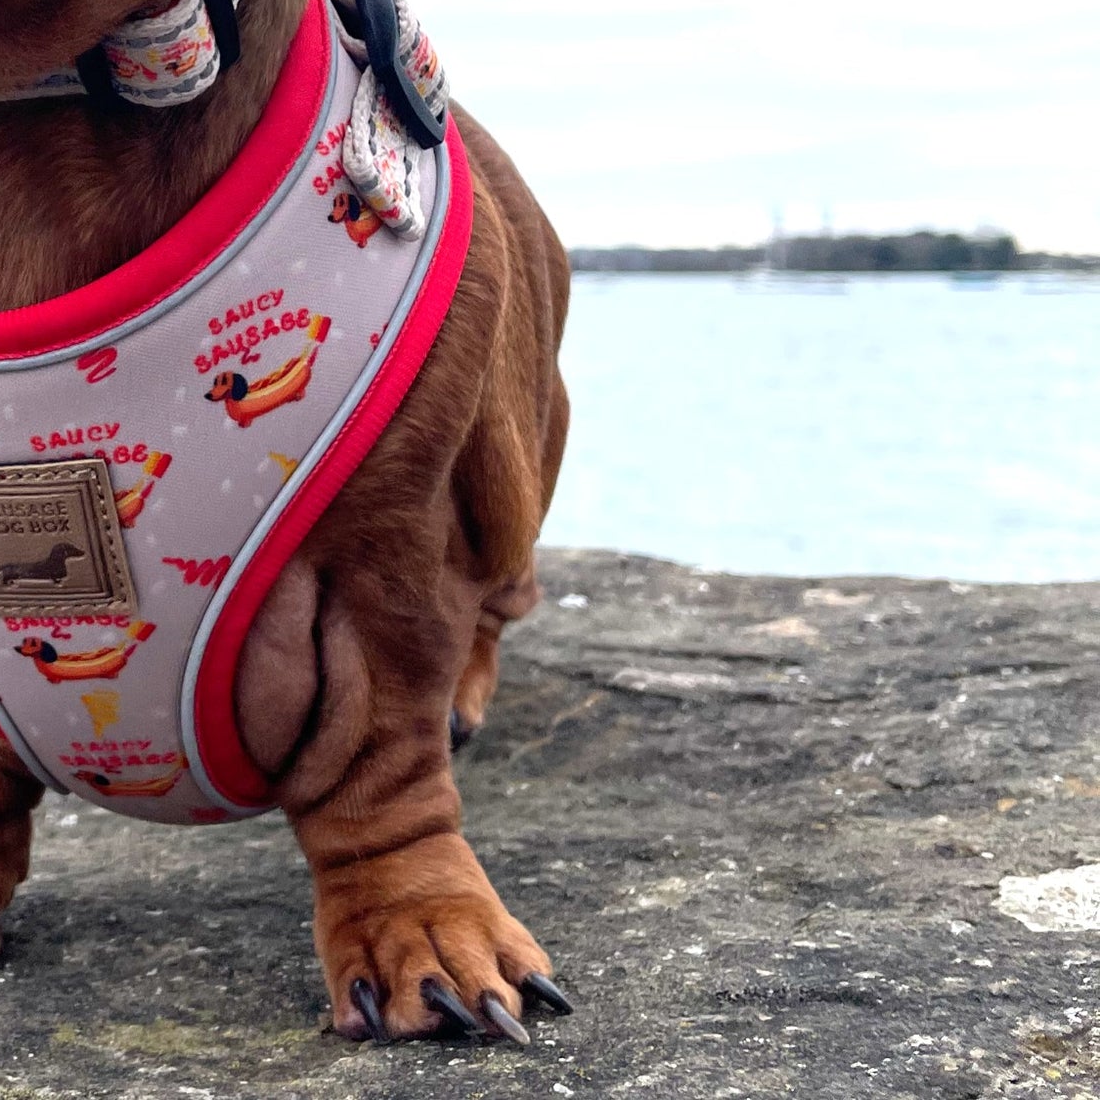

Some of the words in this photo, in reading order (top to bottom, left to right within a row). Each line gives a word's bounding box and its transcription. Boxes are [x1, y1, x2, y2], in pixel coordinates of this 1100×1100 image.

[208, 288, 284, 336] SAUCY
[193, 307, 310, 374] SAUSAGE
[28, 422, 121, 452] SAUCY
[29, 518, 71, 534] BOX
